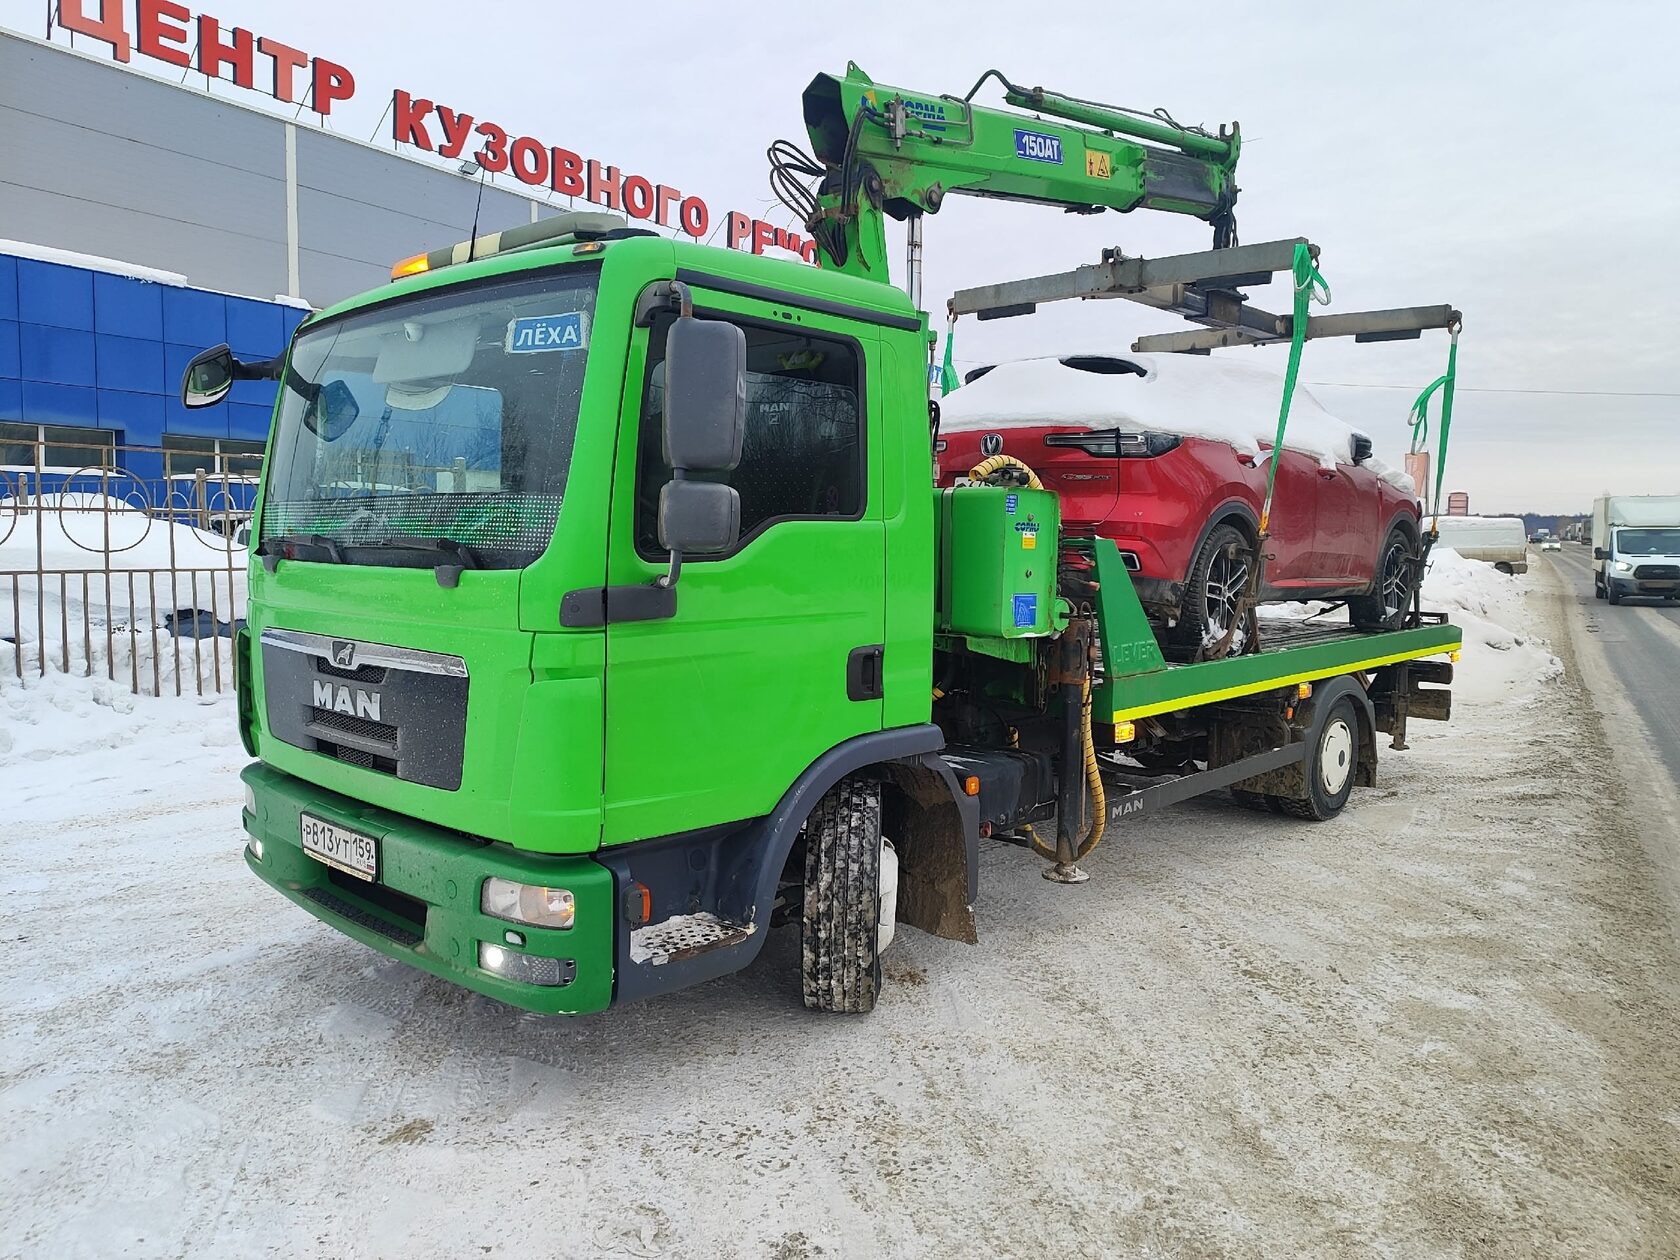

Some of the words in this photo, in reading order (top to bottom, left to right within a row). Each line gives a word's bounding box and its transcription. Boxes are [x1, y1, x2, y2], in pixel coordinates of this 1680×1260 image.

[1022, 134, 1059, 160] 150AT
[393, 89, 709, 237] КУЗОВНОГО
[516, 322, 577, 347] ЛЁХА
[760, 402, 789, 413] MAN
[313, 679, 381, 721] MAN
[1112, 798, 1144, 818] MAN
[352, 837, 371, 860] 159
